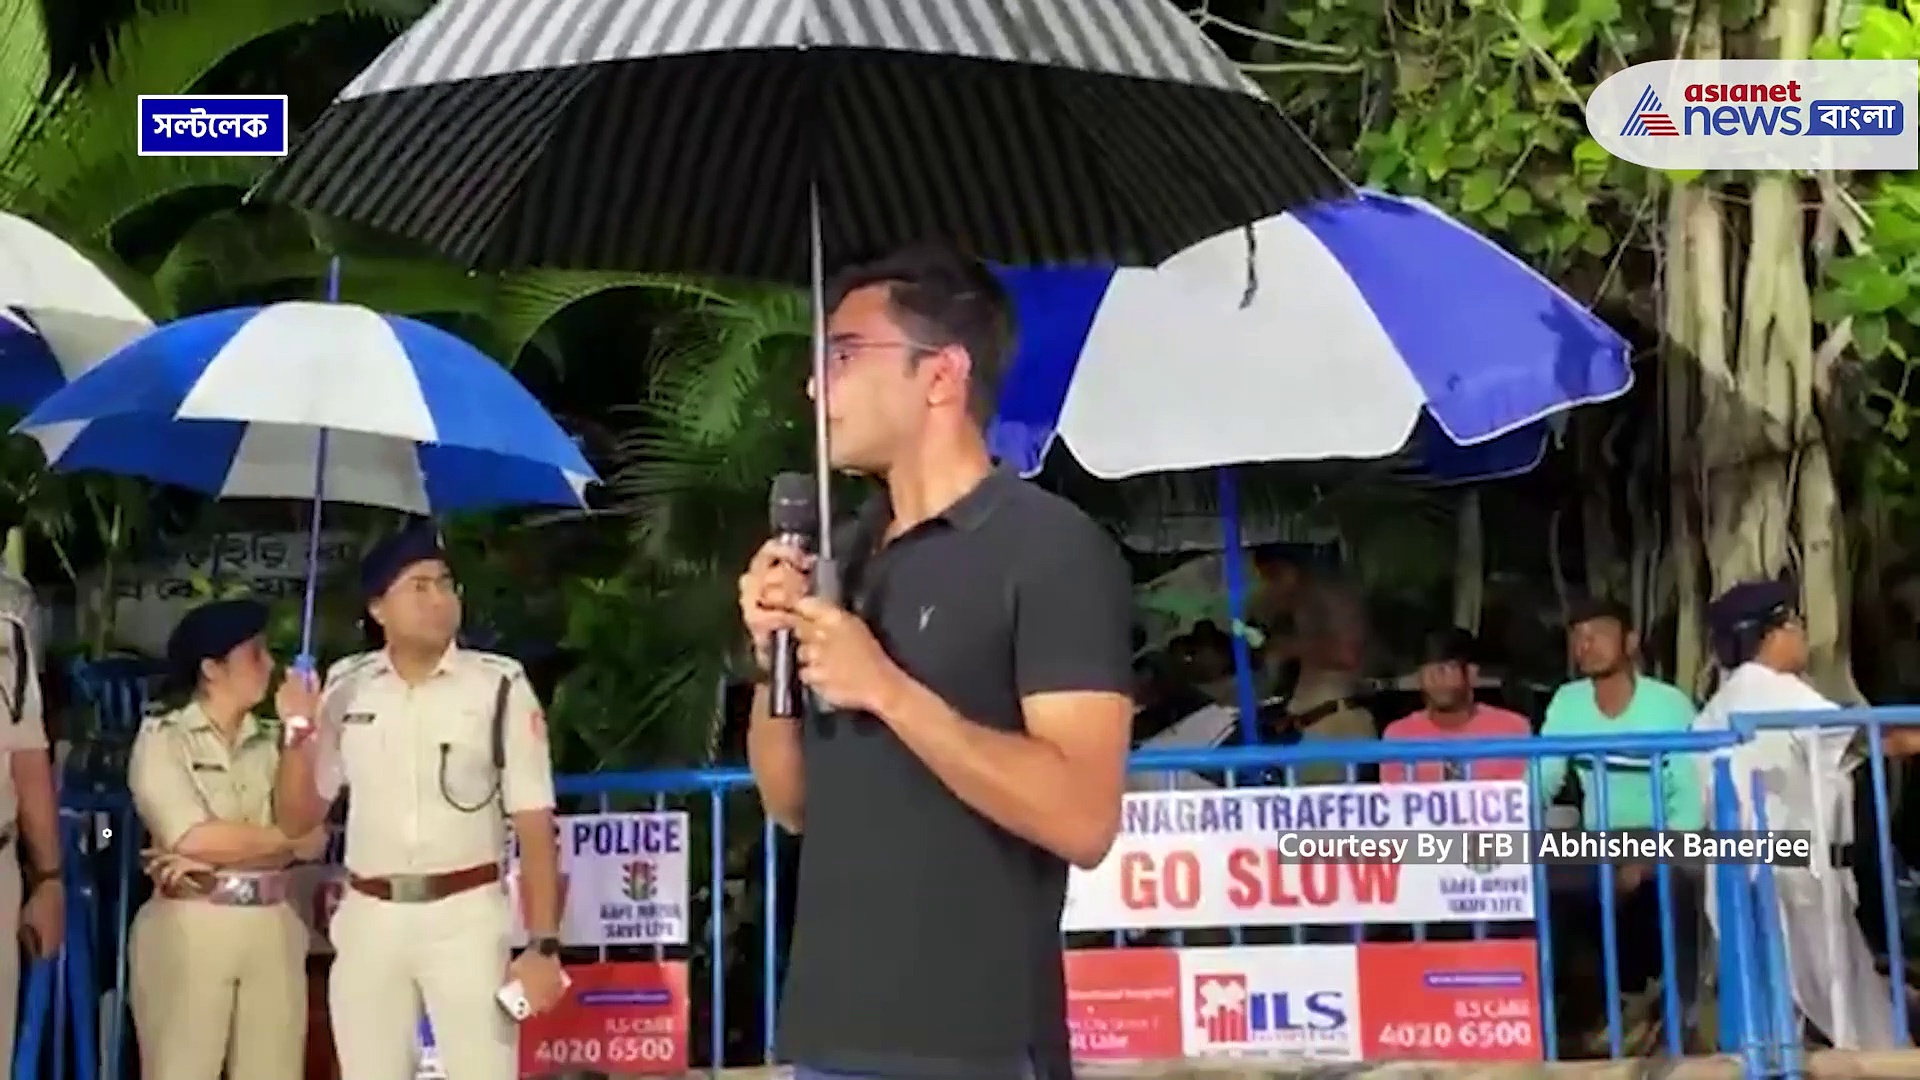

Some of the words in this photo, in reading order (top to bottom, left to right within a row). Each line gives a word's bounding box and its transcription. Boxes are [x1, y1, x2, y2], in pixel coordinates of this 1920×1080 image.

[1125, 796, 1243, 834] NAGAR
[1253, 793, 1391, 831] TRAFFIC
[1403, 786, 1525, 828] POLICE
[572, 820, 681, 857] POLICE
[1120, 850, 1201, 910] GO
[1227, 844, 1402, 910] SLOW
[1250, 991, 1347, 1031] ILS
[534, 1037, 601, 1064] 4020
[607, 1036, 675, 1062] 6500
[1378, 1021, 1451, 1049] 4020
[1458, 1020, 1532, 1048] 6500
